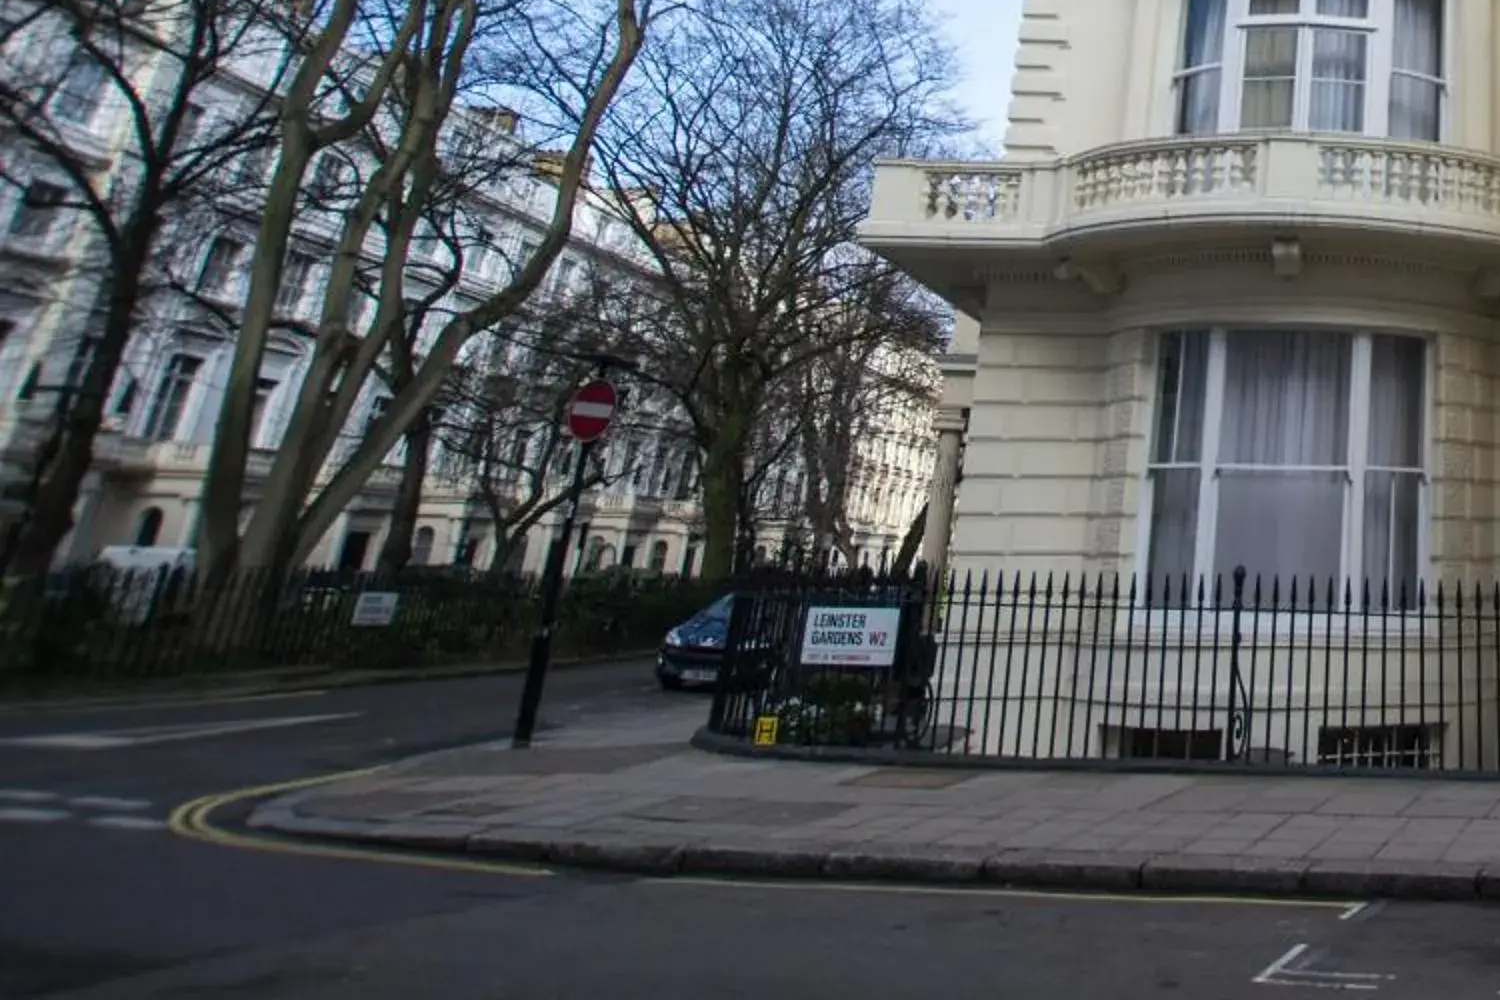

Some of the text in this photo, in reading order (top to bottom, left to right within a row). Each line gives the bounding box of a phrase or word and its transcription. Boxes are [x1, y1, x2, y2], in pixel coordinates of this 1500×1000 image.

[813, 613, 867, 628] LEINSTER
[811, 630, 888, 646] GARDENS W2
